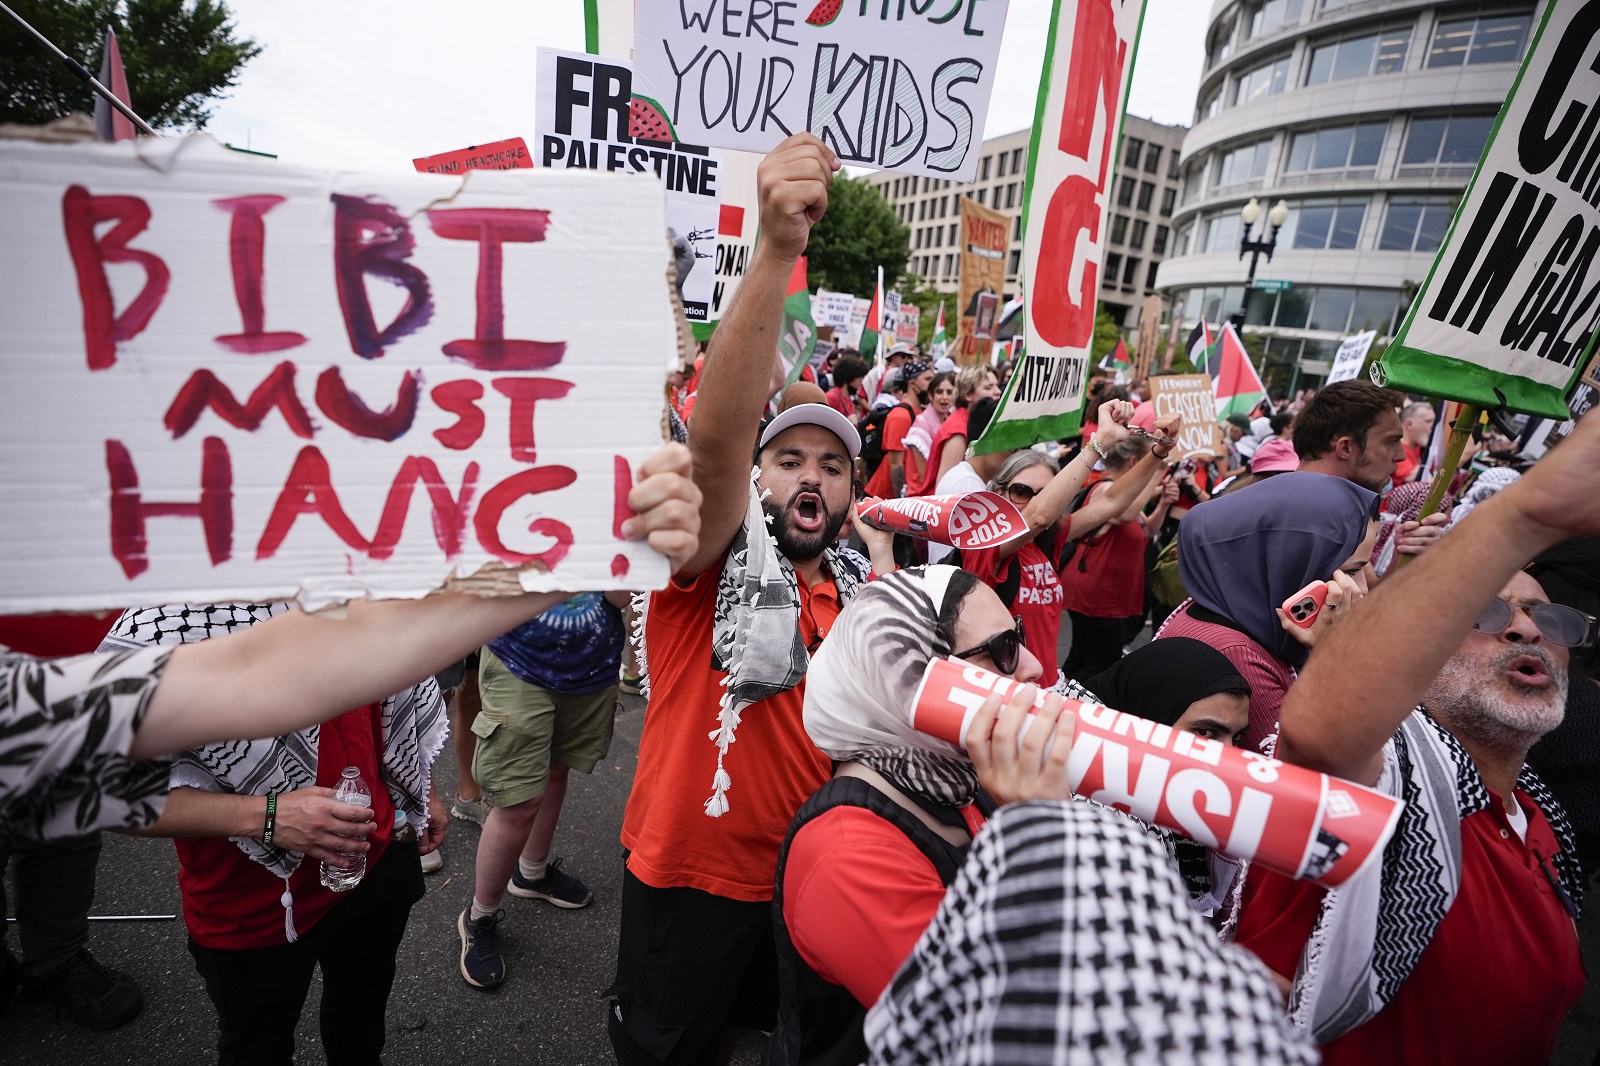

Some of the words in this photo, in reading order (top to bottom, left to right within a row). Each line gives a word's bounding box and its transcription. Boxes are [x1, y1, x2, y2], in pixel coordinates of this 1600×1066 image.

[680, 0, 799, 46] WERE
[662, 39, 795, 137] YOUR
[806, 43, 984, 172] KIDS
[465, 147, 526, 169] HEALTHCARE
[63, 184, 568, 371] BIBI
[1428, 171, 1558, 335] IN
[164, 360, 577, 464] MUST
[1155, 390, 1217, 425] CEASEFIRE
[1176, 424, 1213, 453] NOW
[105, 436, 634, 581] HANG!
[966, 513, 1012, 546] STOP
[948, 686, 1274, 862] ISRL
